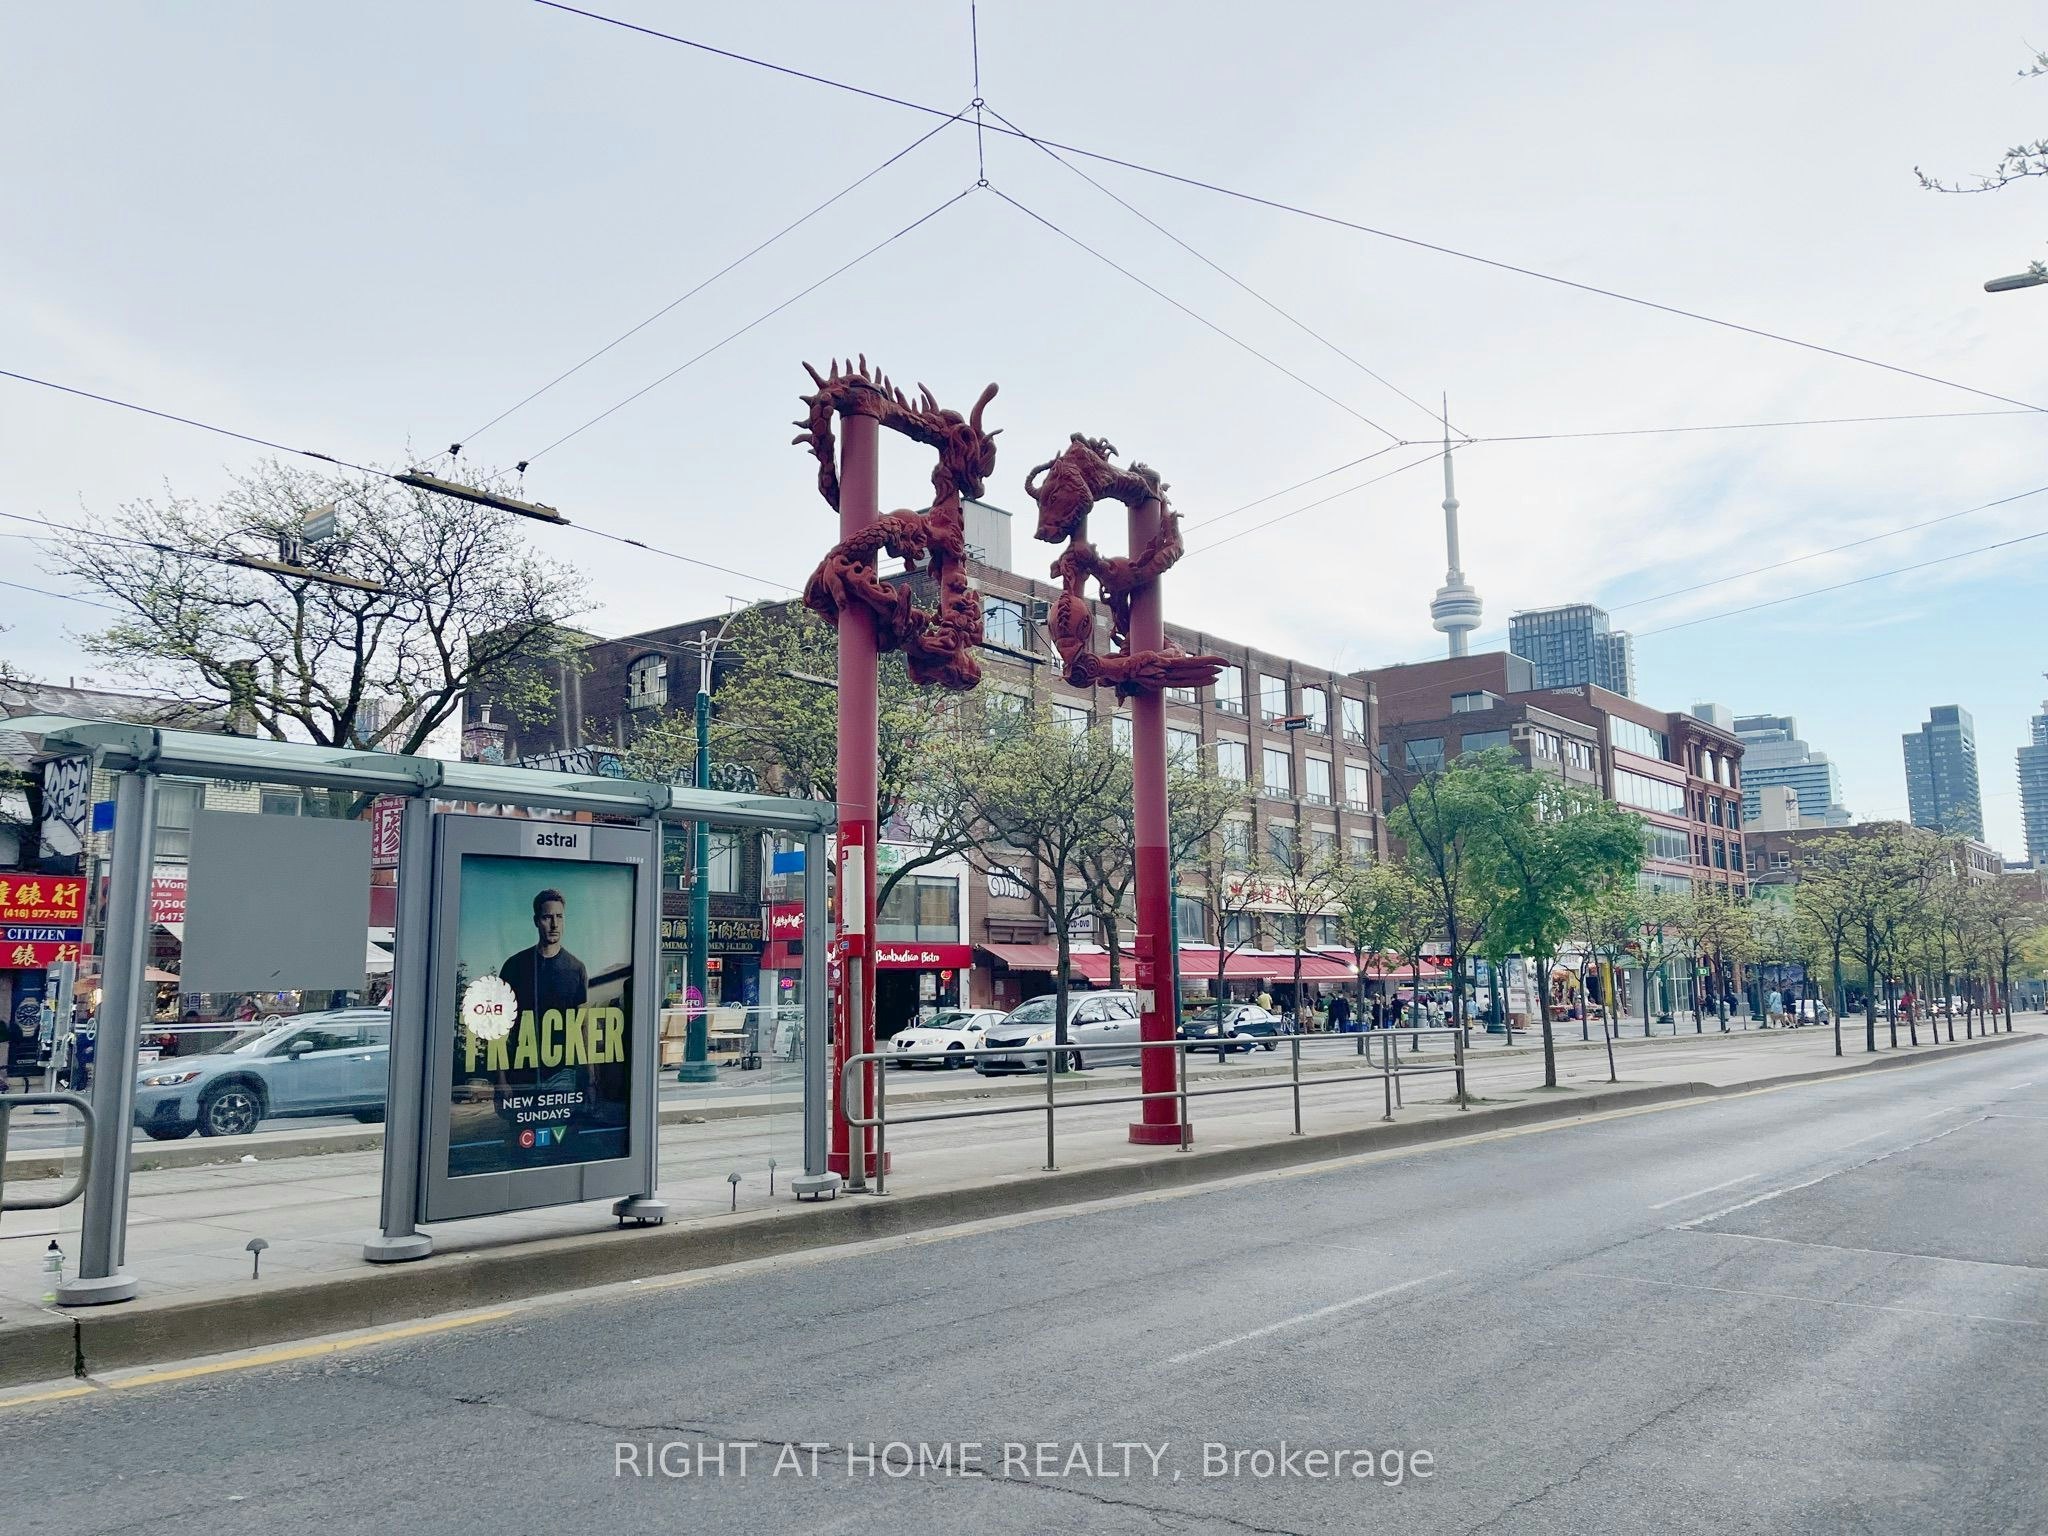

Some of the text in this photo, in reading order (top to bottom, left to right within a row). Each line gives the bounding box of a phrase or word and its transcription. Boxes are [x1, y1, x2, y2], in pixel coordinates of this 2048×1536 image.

[536, 832, 577, 848] astral
[4, 908, 29, 918] (416)
[7, 928, 66, 941] CITIZEN
[502, 1091, 584, 1110] NEW SERIES
[516, 1108, 571, 1123] SUNDAYS
[519, 1127, 567, 1148] CTV
